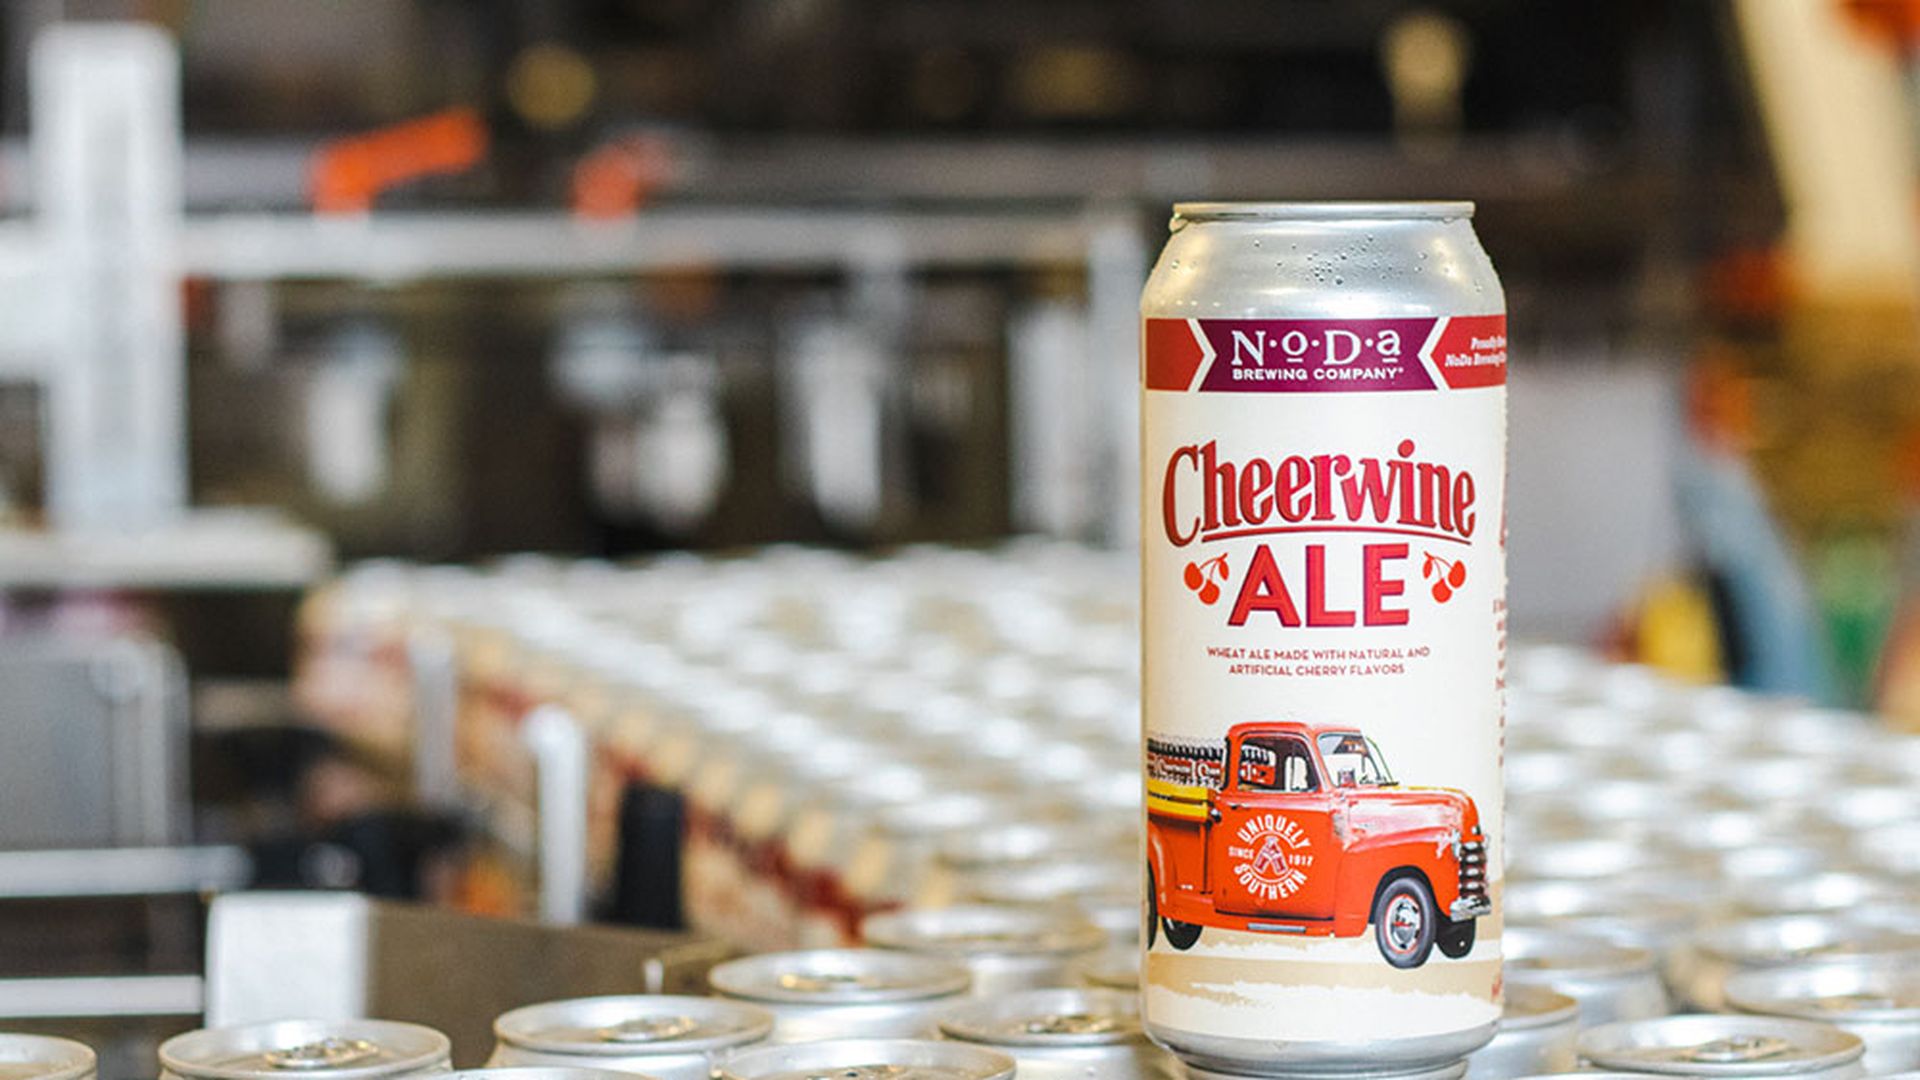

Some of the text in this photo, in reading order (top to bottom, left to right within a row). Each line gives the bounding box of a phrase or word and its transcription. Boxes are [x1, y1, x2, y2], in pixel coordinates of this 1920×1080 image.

[1232, 367, 1308, 380] BREWING
[1162, 438, 1476, 548] Cheerwine
[1227, 543, 1410, 628] ALE
[1206, 646, 1431, 661] WHEAT ALE MADE WITH NATURAL AND
[1228, 663, 1405, 677] ARTIFICIAL CHERRY FLAVORS
[1236, 814, 1312, 849] UNIQUELY
[1228, 846, 1254, 859] SINCE
[1234, 863, 1307, 900] SOUTHERN
